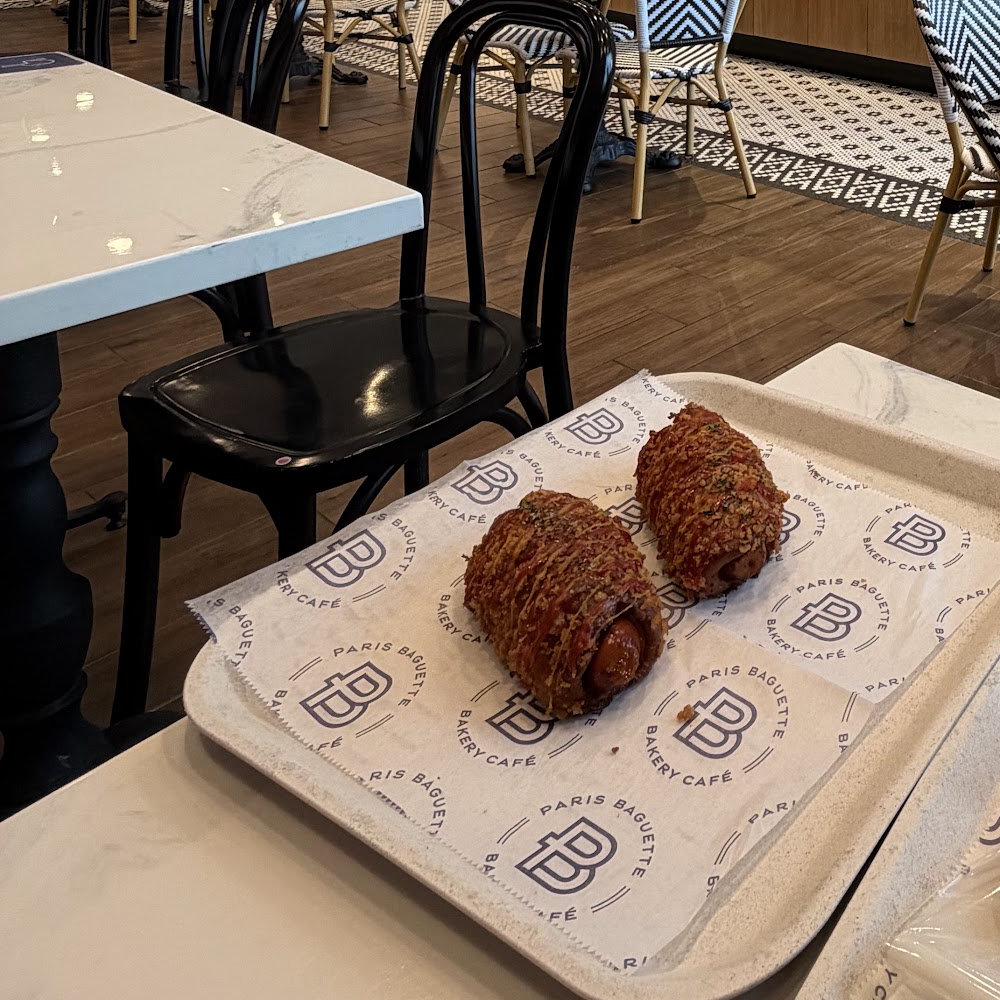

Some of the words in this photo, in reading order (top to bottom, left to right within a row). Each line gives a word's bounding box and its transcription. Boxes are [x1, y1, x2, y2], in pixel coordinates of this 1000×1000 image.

[641, 377, 662, 398] KERY
[662, 395, 685, 404] CAF
[621, 401, 647, 444] BAGUETTE
[544, 431, 566, 453] KERY
[566, 447, 601, 459] CAFÉ
[519, 452, 544, 490] BAGUET
[604, 483, 633, 495] PAR
[427, 489, 449, 510] KERY
[449, 508, 487, 524] CAFÉ
[793, 494, 826, 537] BAGUETTE
[884, 502, 914, 514] PAR
[390, 517, 417, 581] BAGUETTE
[862, 537, 896, 567] BAKERY
[898, 561, 937, 572] CAFÉ
[276, 568, 298, 598] KERY
[296, 594, 342, 609] CAFÉ
[796, 578, 844, 593] PARIS
[850, 579, 890, 630] BAGUETTE
[437, 594, 462, 636] BAKERY
[461, 632, 486, 644] CA
[766, 618, 800, 654] BAKERY
[802, 649, 847, 660] CAFÉ
[333, 642, 393, 657] PARIS
[397, 646, 427, 707] BAGUETTE
[865, 677, 905, 692] PAR
[686, 665, 741, 688] PARIS
[747, 666, 789, 739] BAGUETTE
[456, 709, 486, 758] BAKERY
[486, 754, 537, 767] CAFÉ
[646, 725, 681, 780] BAKERY
[682, 769, 733, 787] CAFÉ
[369, 769, 406, 781] RIS
[412, 773, 447, 836] BAGUET
[539, 795, 606, 816] PARIS
[613, 799, 655, 878] BAGUETTE
